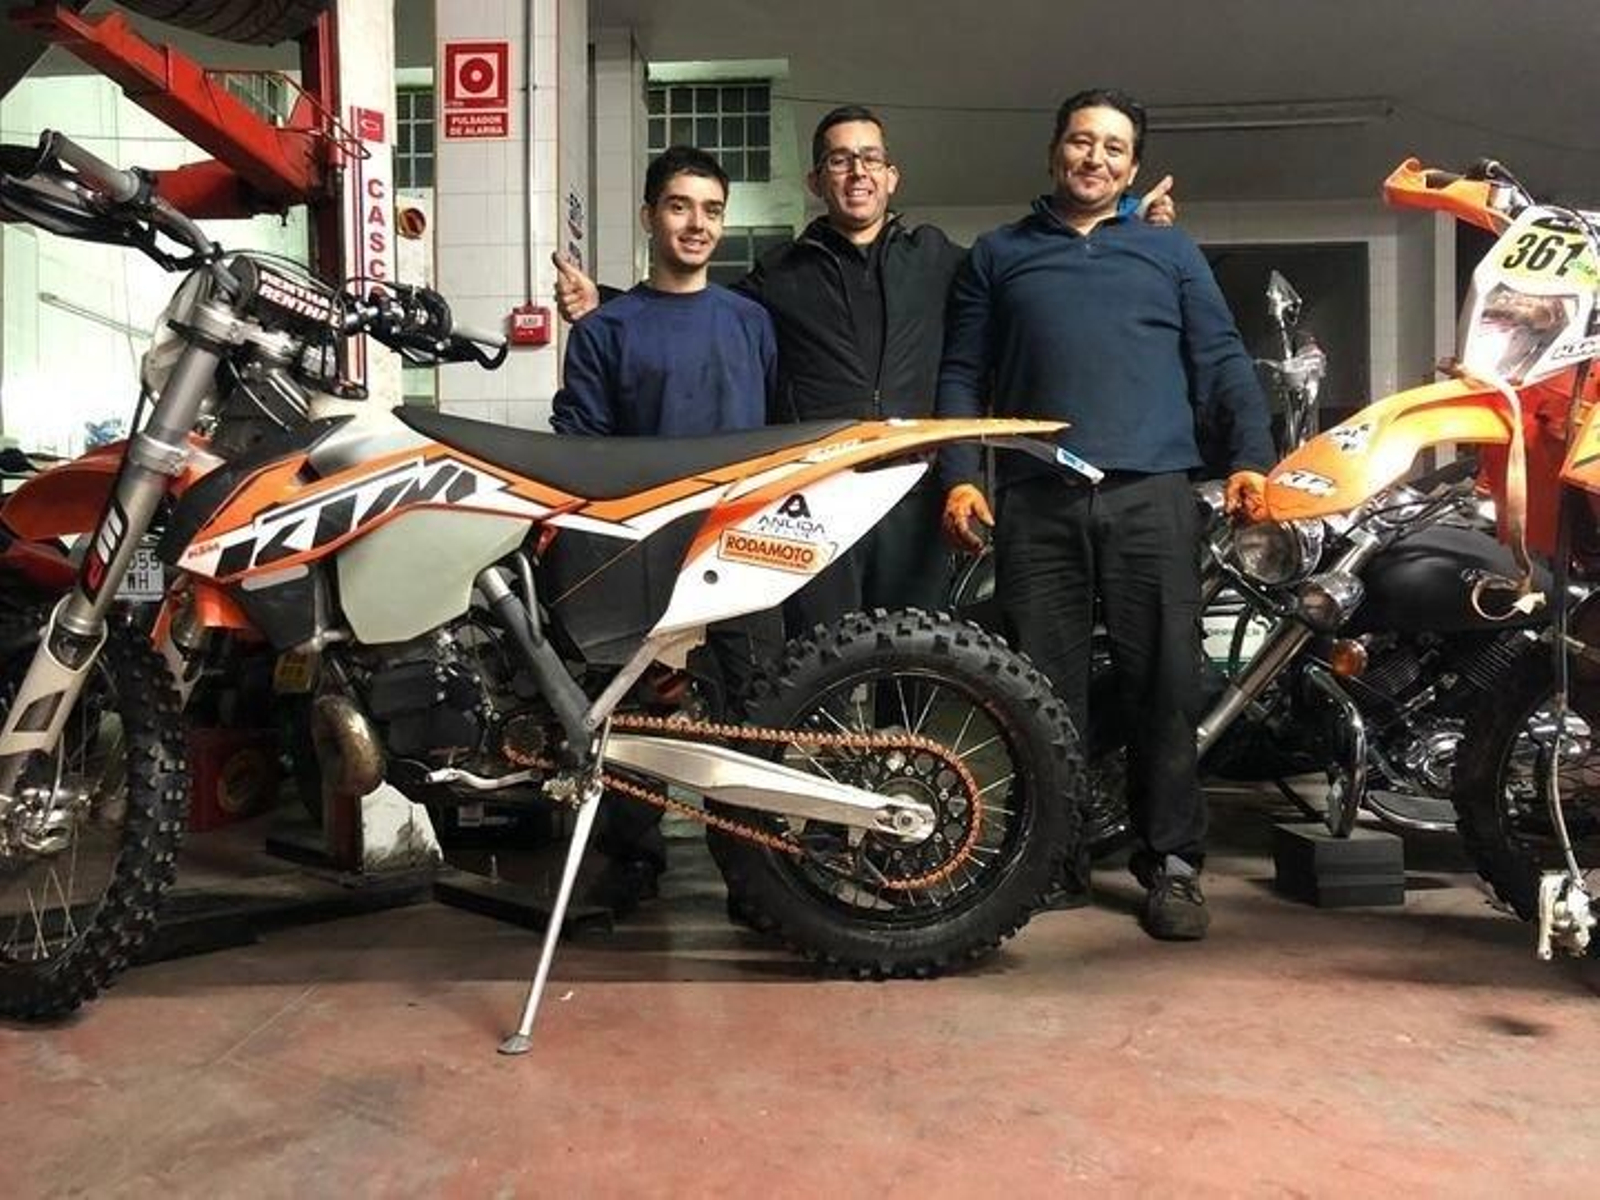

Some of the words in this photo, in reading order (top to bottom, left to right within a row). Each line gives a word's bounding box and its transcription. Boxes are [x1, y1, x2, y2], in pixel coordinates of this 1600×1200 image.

[449, 126, 463, 136] DE
[465, 125, 505, 135] ALARMA
[451, 115, 503, 125] PULSADOR
[1502, 232, 1589, 277] 361
[258, 282, 341, 329] RENTHAL
[725, 535, 814, 564] RODAMOTO
